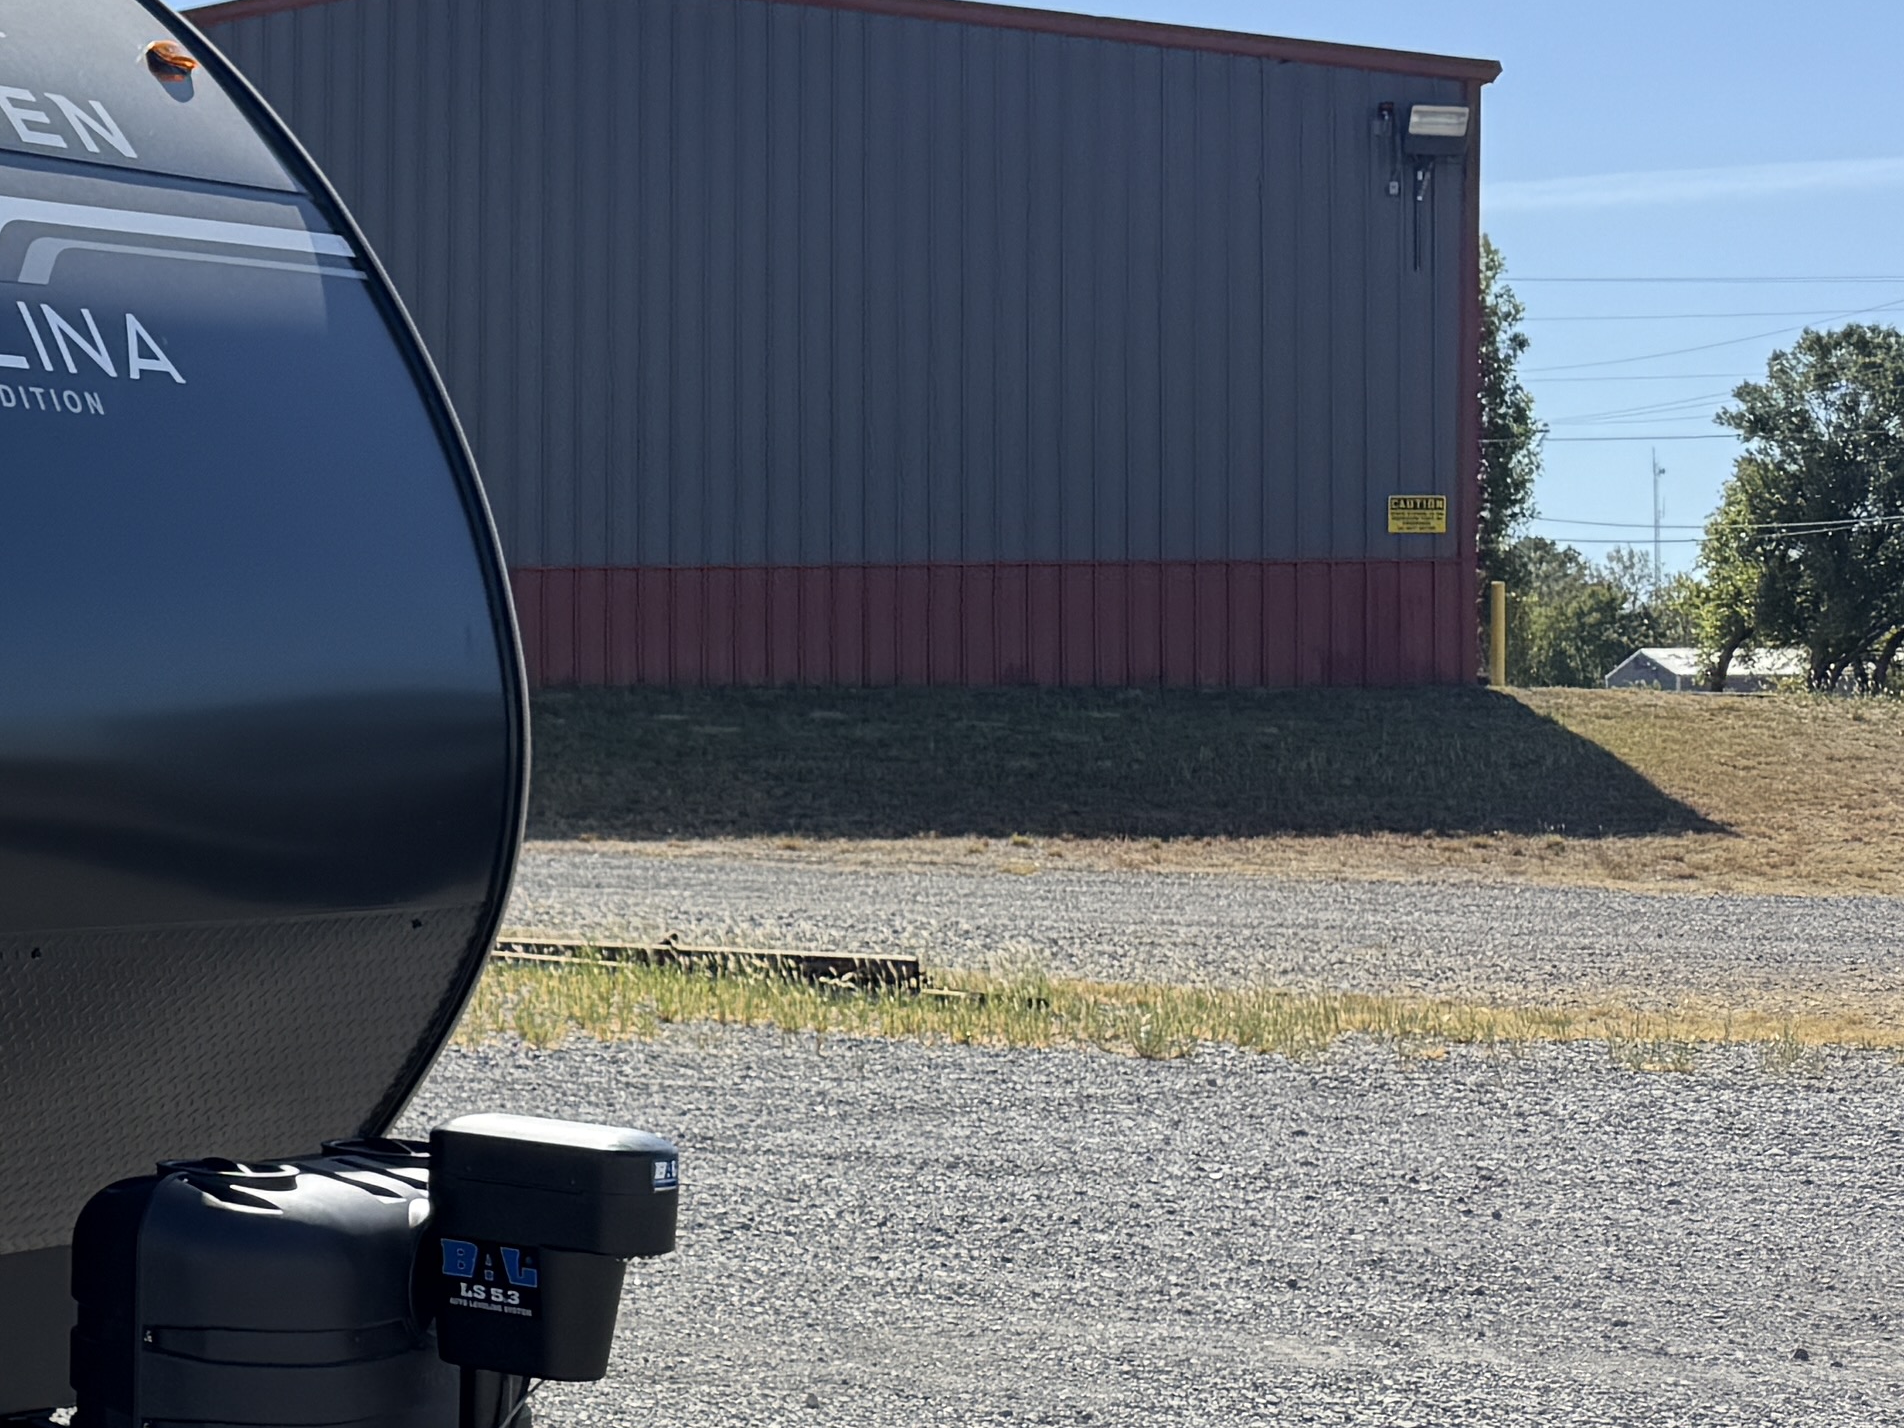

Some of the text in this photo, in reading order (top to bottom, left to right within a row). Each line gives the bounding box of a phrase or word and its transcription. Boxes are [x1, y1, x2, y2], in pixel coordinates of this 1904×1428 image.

[1391, 498, 1444, 509] CAUTION
[440, 1237, 538, 1288] BAL
[459, 1281, 486, 1300] LS
